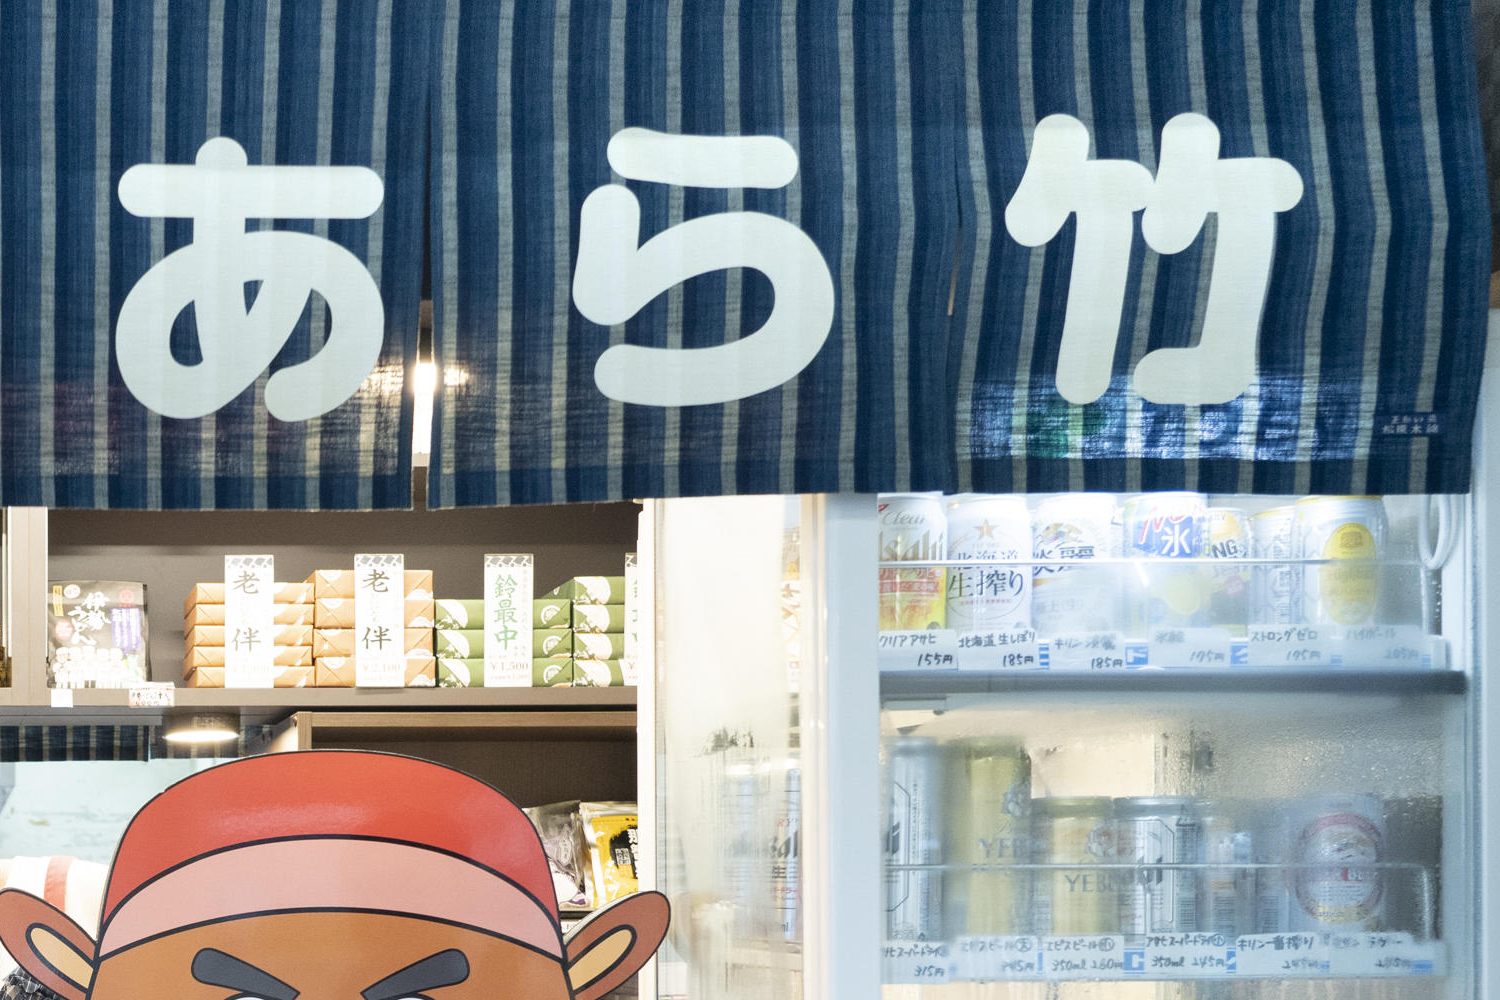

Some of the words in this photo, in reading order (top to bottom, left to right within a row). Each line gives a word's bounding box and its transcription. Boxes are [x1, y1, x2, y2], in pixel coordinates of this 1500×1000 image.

[115, 112, 1304, 423] あら竹
[493, 574, 519, 651] 鈴最中
[949, 569, 1025, 600] 生搾り
